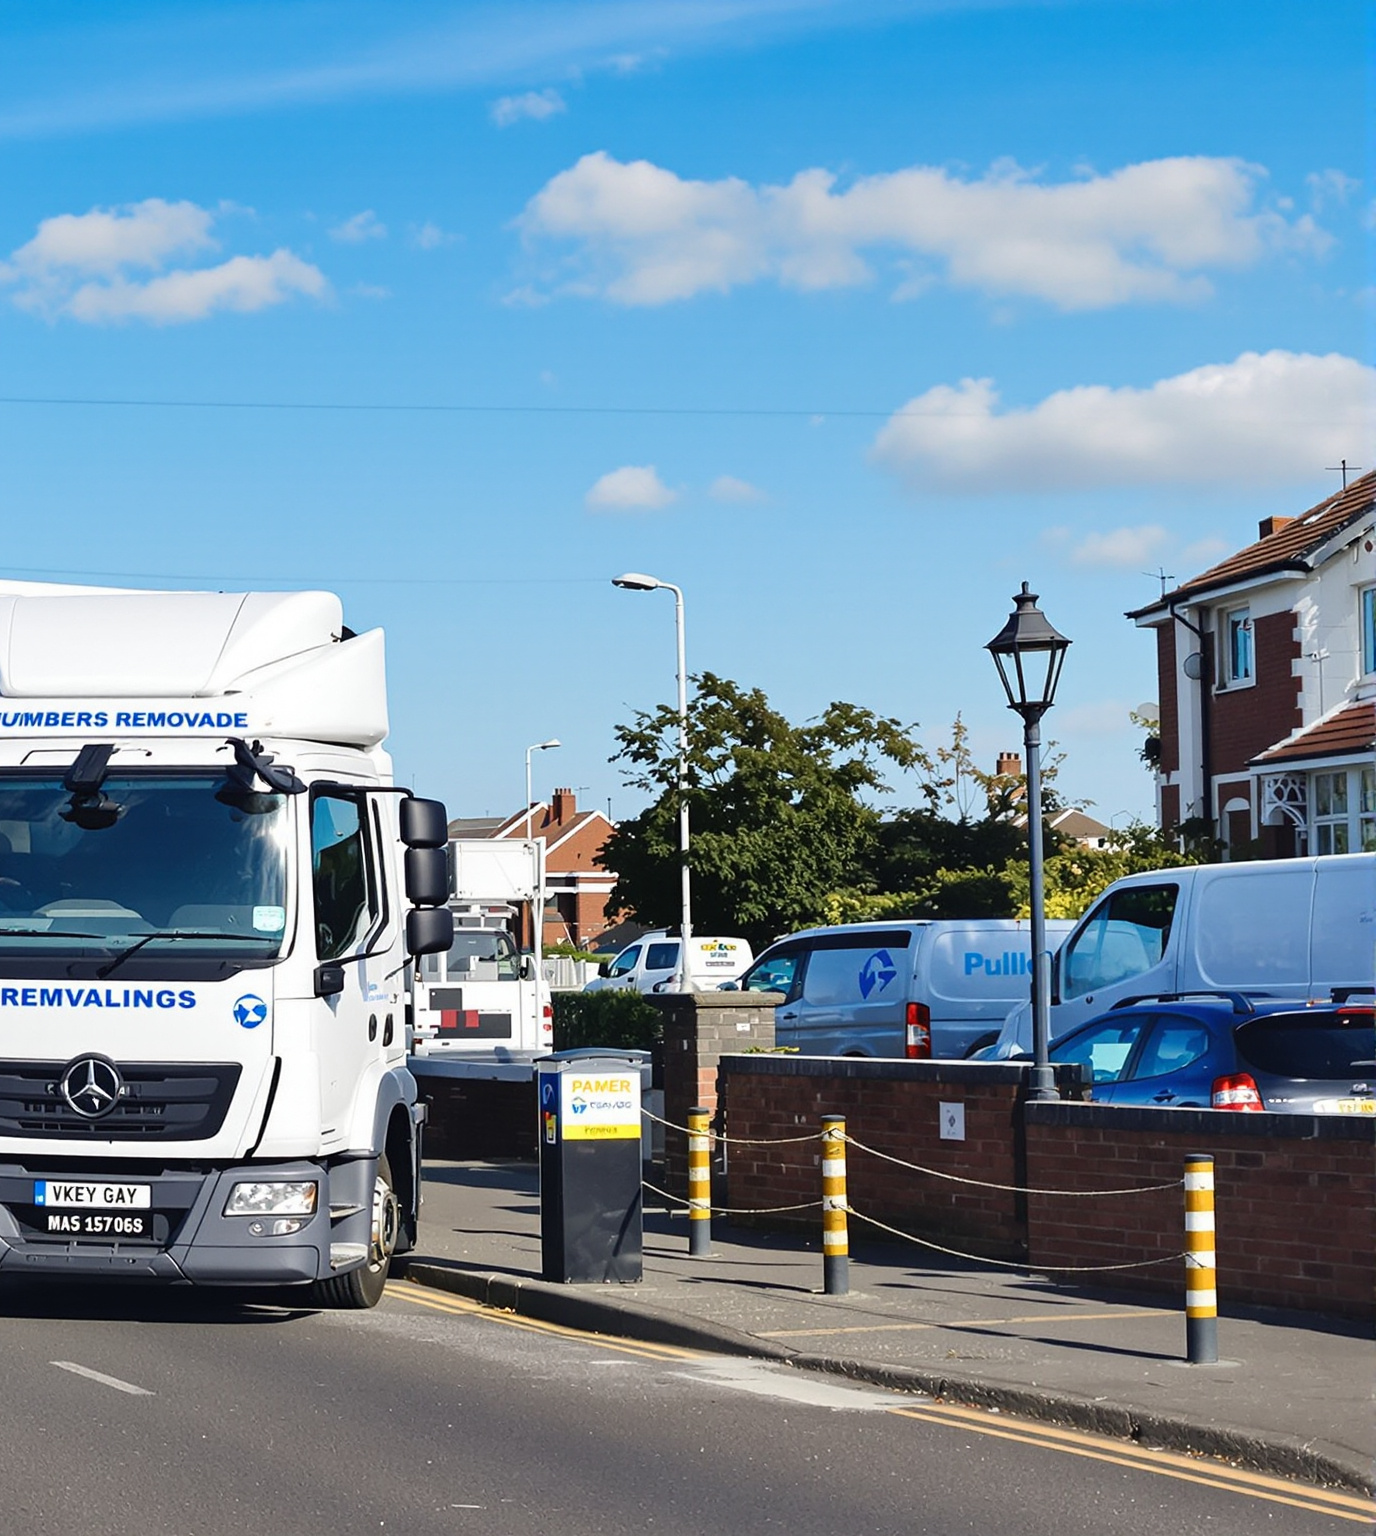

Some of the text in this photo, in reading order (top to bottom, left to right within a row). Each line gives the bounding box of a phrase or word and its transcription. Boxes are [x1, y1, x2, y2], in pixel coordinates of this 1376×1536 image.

[115, 711, 249, 728] REMOVADE
[571, 1079, 631, 1093] PAMER
[52, 1185, 97, 1203] VKEY
[103, 1187, 137, 1204] GAY
[47, 1214, 81, 1232] MAS
